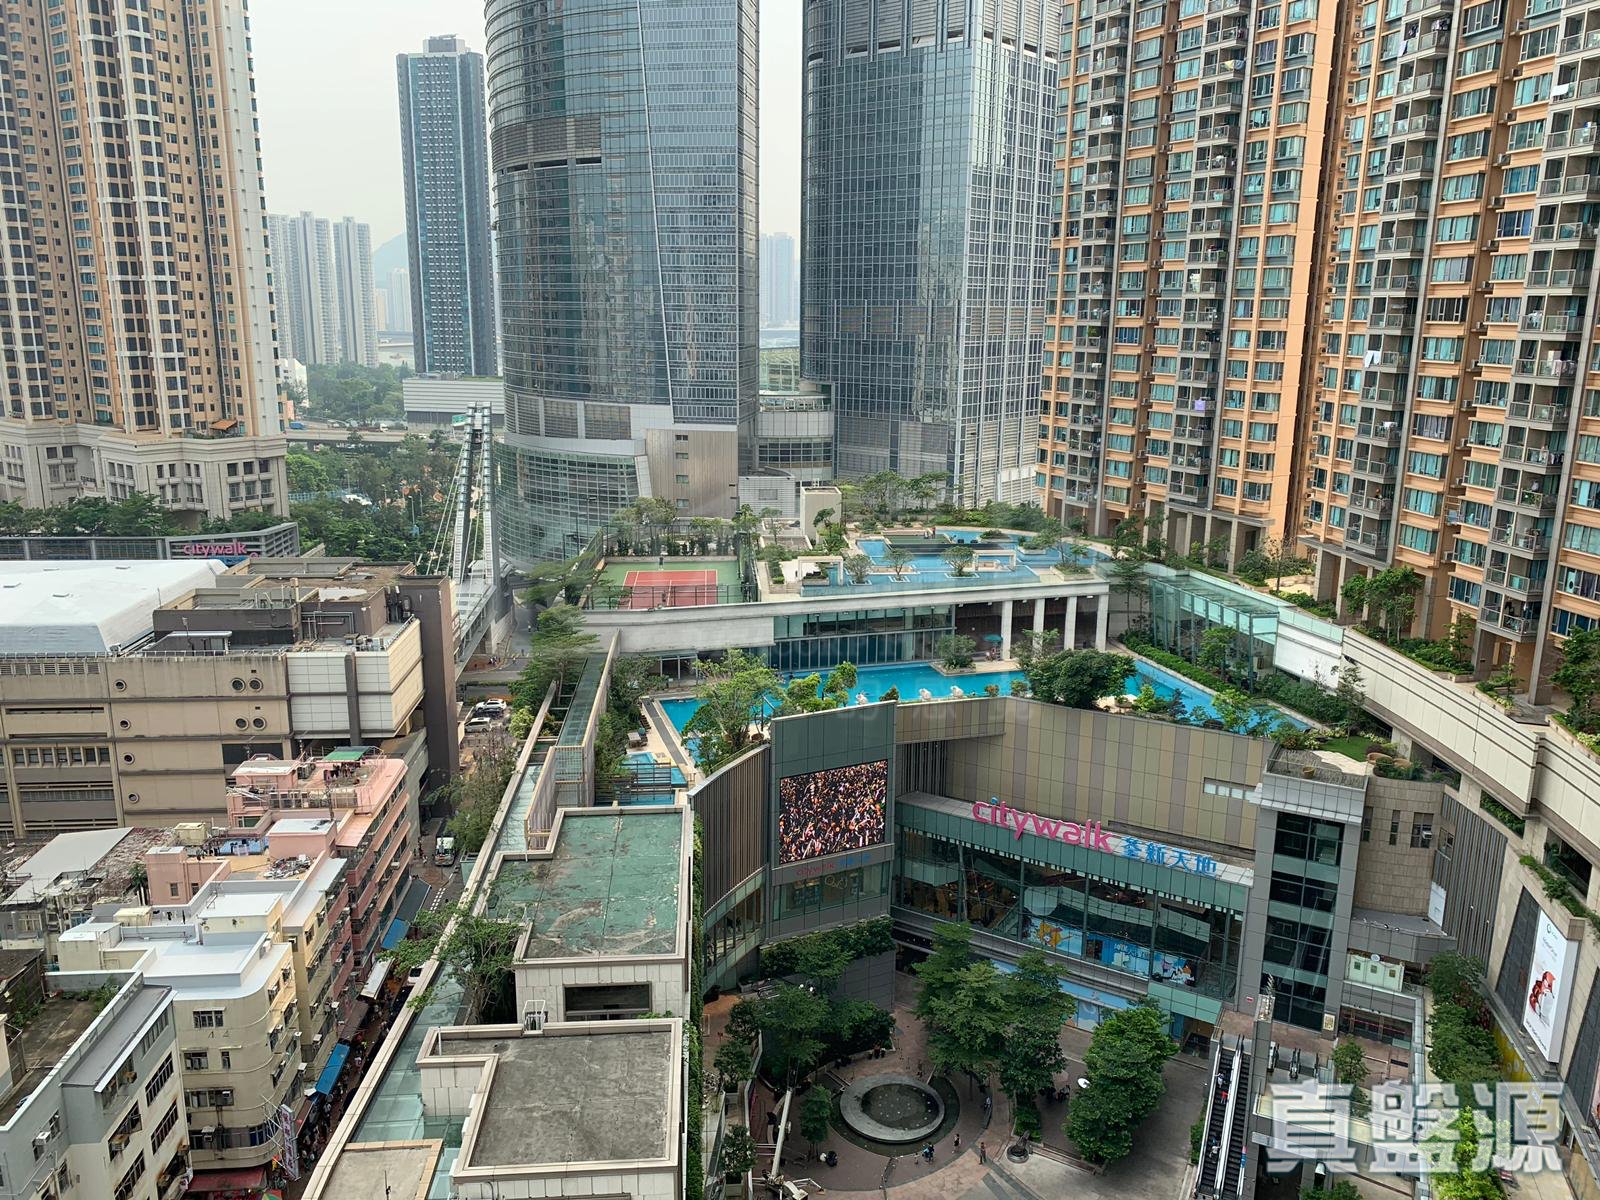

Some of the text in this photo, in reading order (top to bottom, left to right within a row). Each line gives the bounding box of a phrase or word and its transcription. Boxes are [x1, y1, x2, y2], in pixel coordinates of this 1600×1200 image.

[184, 541, 247, 556] citywalk
[972, 795, 1217, 876] citywalk 荃新天地
